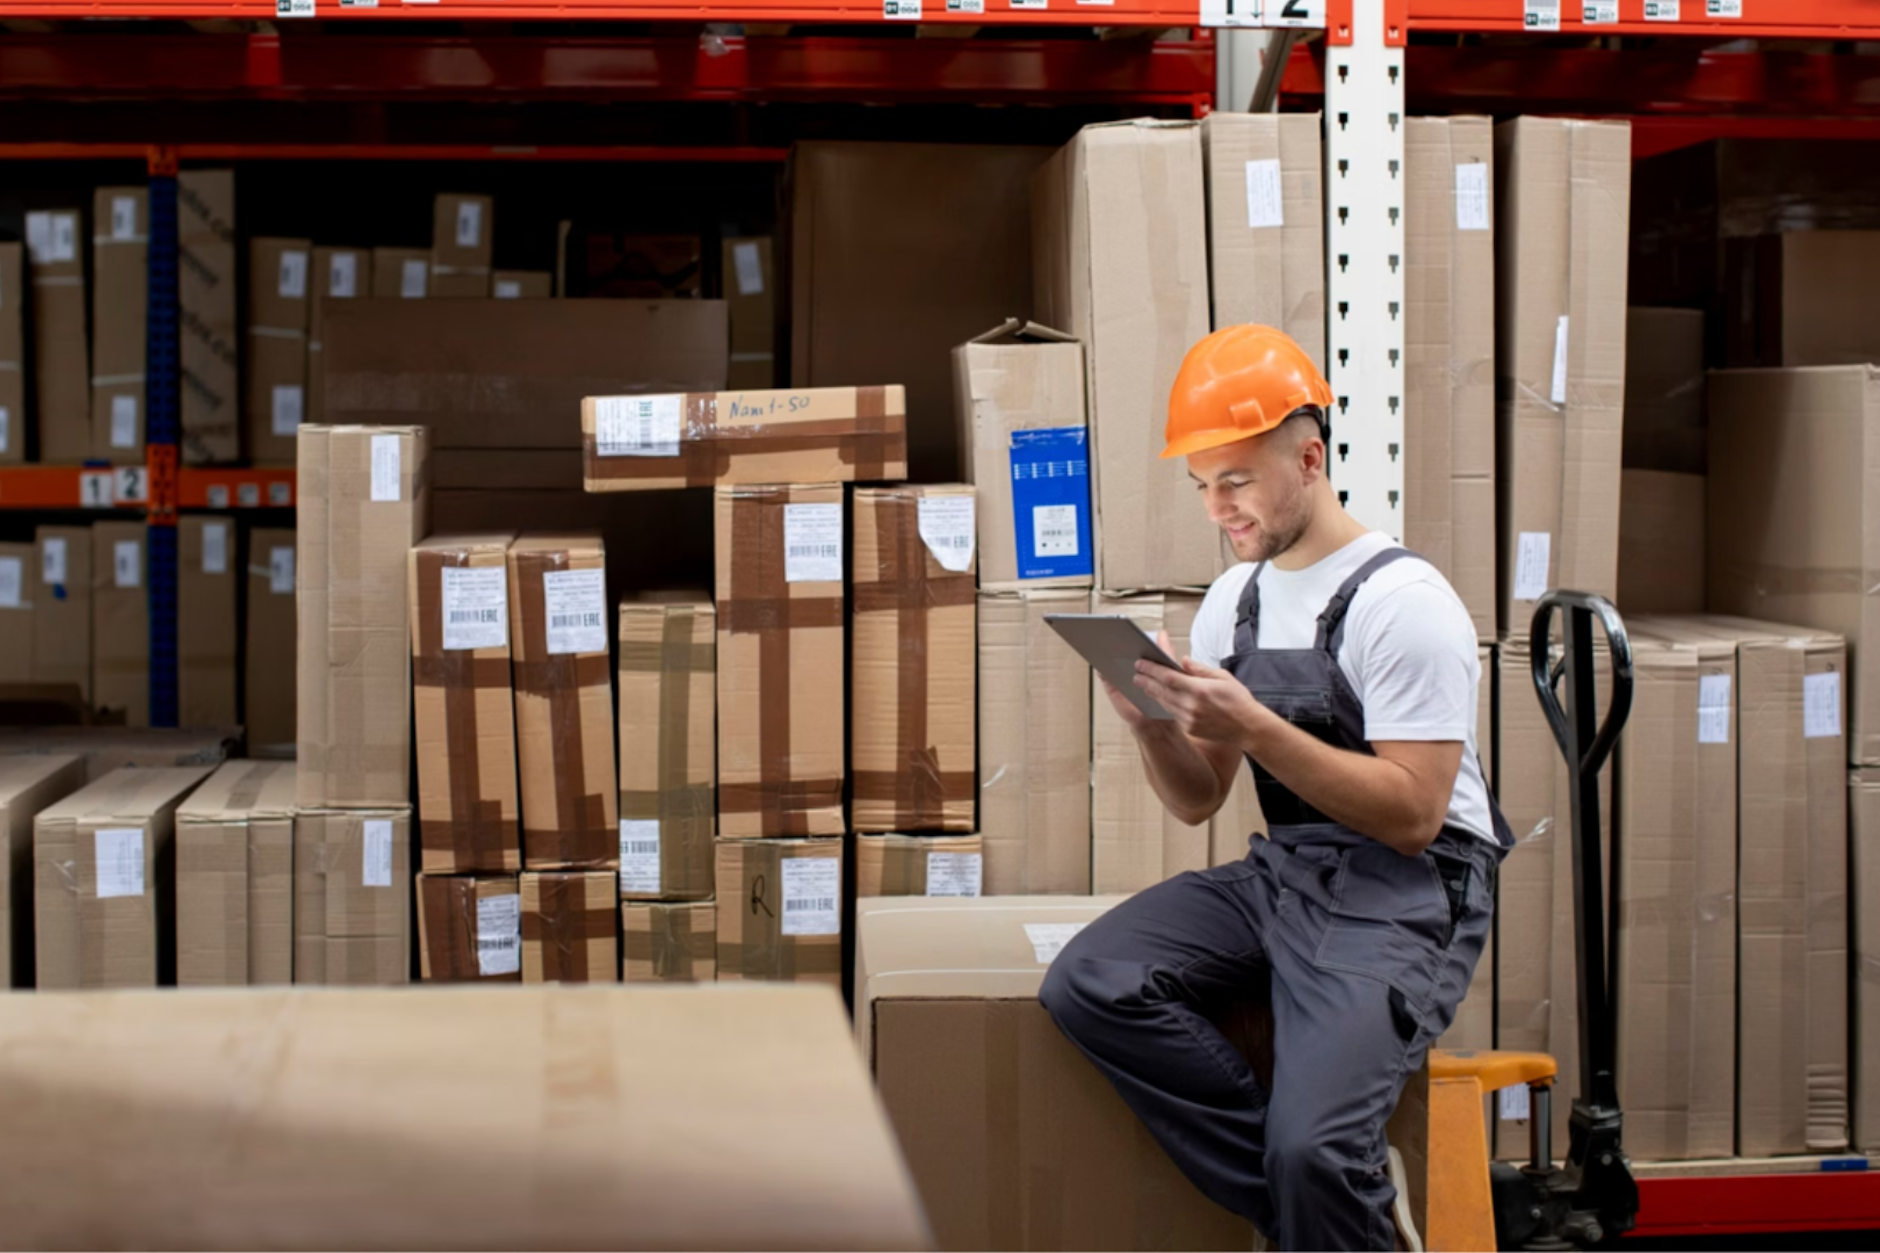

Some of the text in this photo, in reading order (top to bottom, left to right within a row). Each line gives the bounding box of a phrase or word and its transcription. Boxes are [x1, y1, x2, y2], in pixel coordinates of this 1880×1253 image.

[124, 469, 139, 499] 2
[583, 612, 600, 627] EAC
[751, 874, 775, 919] R
